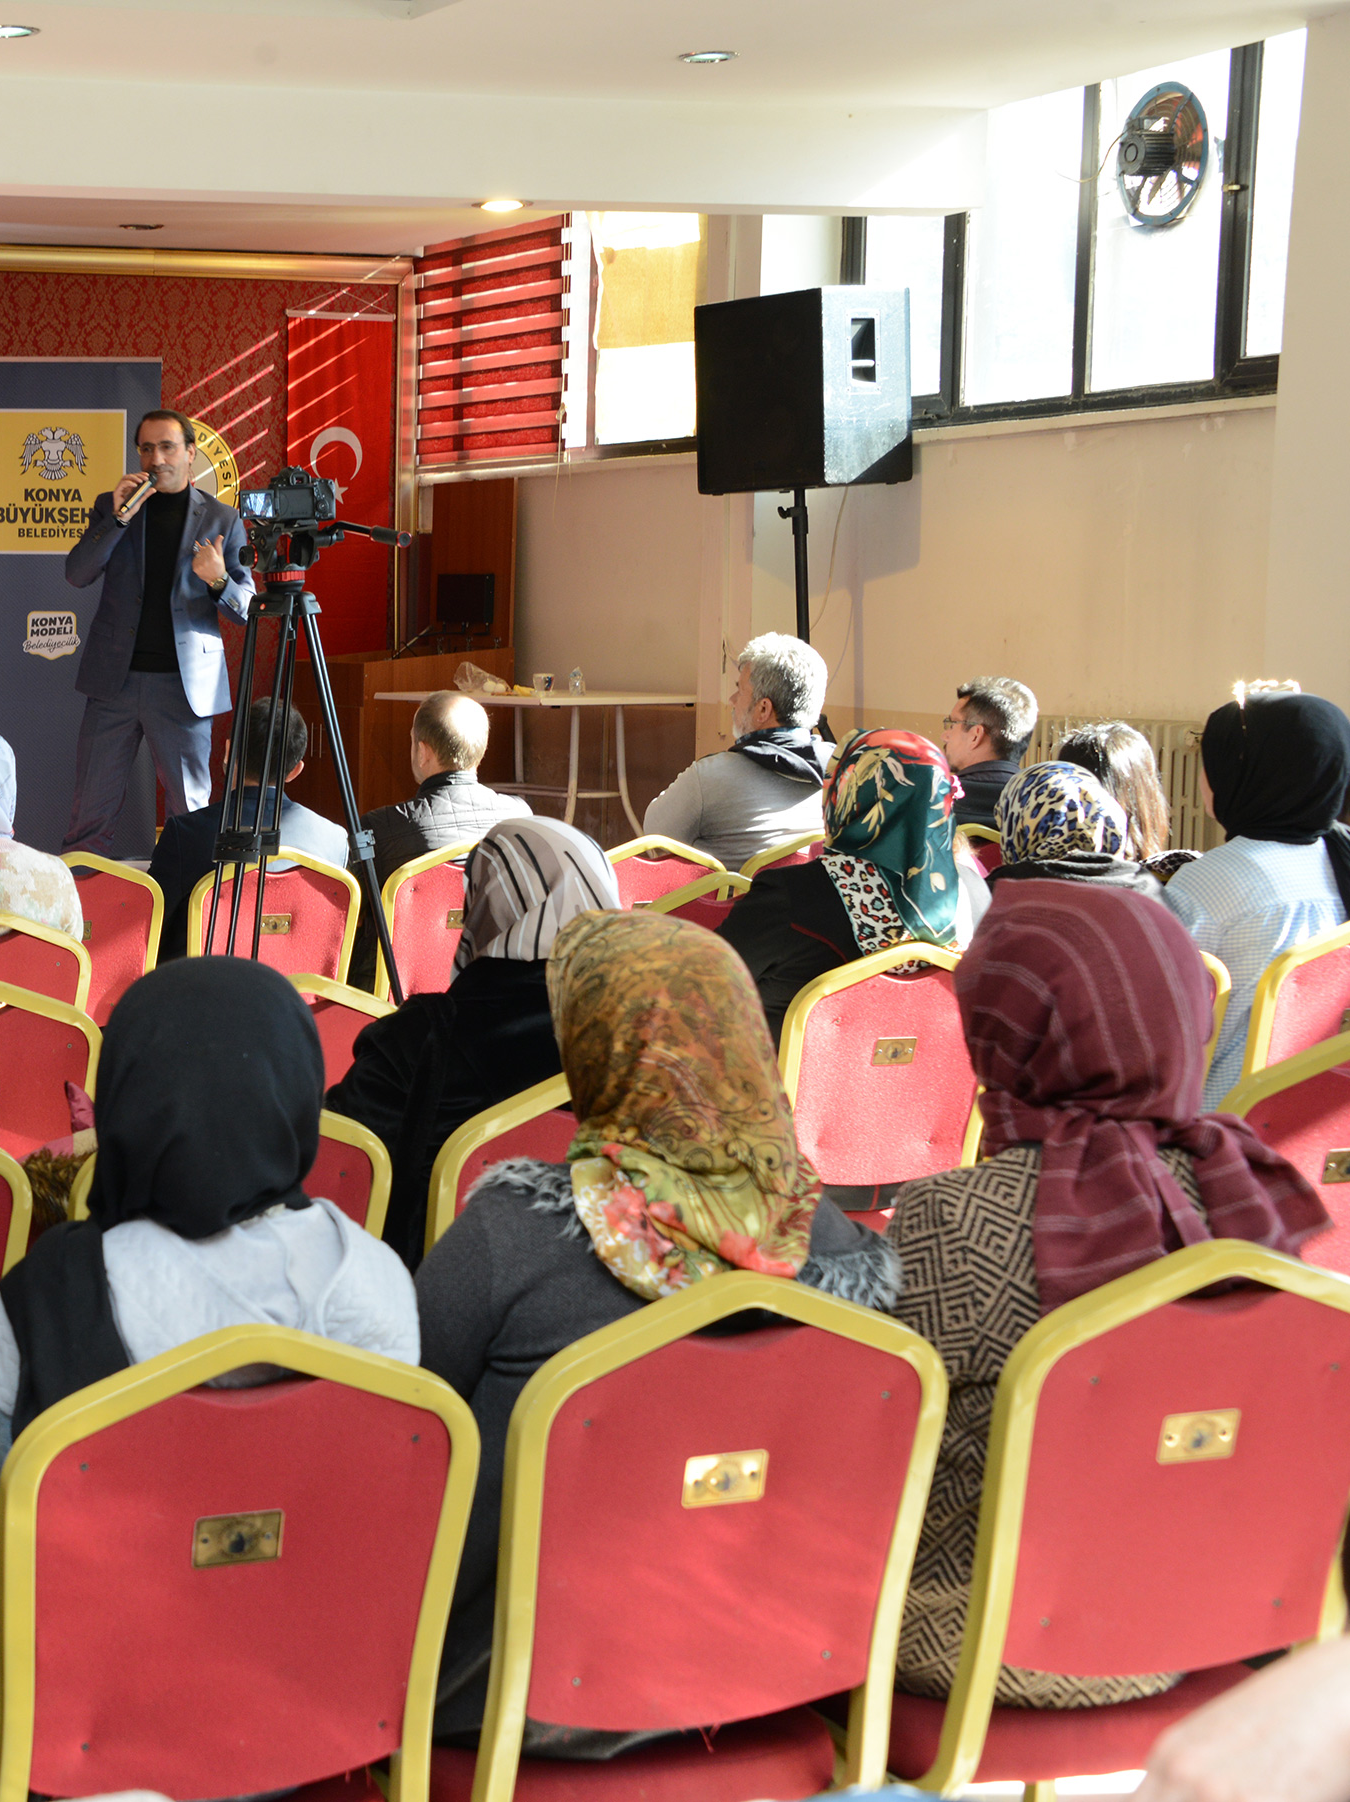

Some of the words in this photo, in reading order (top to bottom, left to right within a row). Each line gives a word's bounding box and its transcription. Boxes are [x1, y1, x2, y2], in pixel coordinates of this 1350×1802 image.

[24, 488, 83, 502] KONYA
[31, 616, 73, 627] KONYA
[25, 636, 80, 653] Belediyecilik
